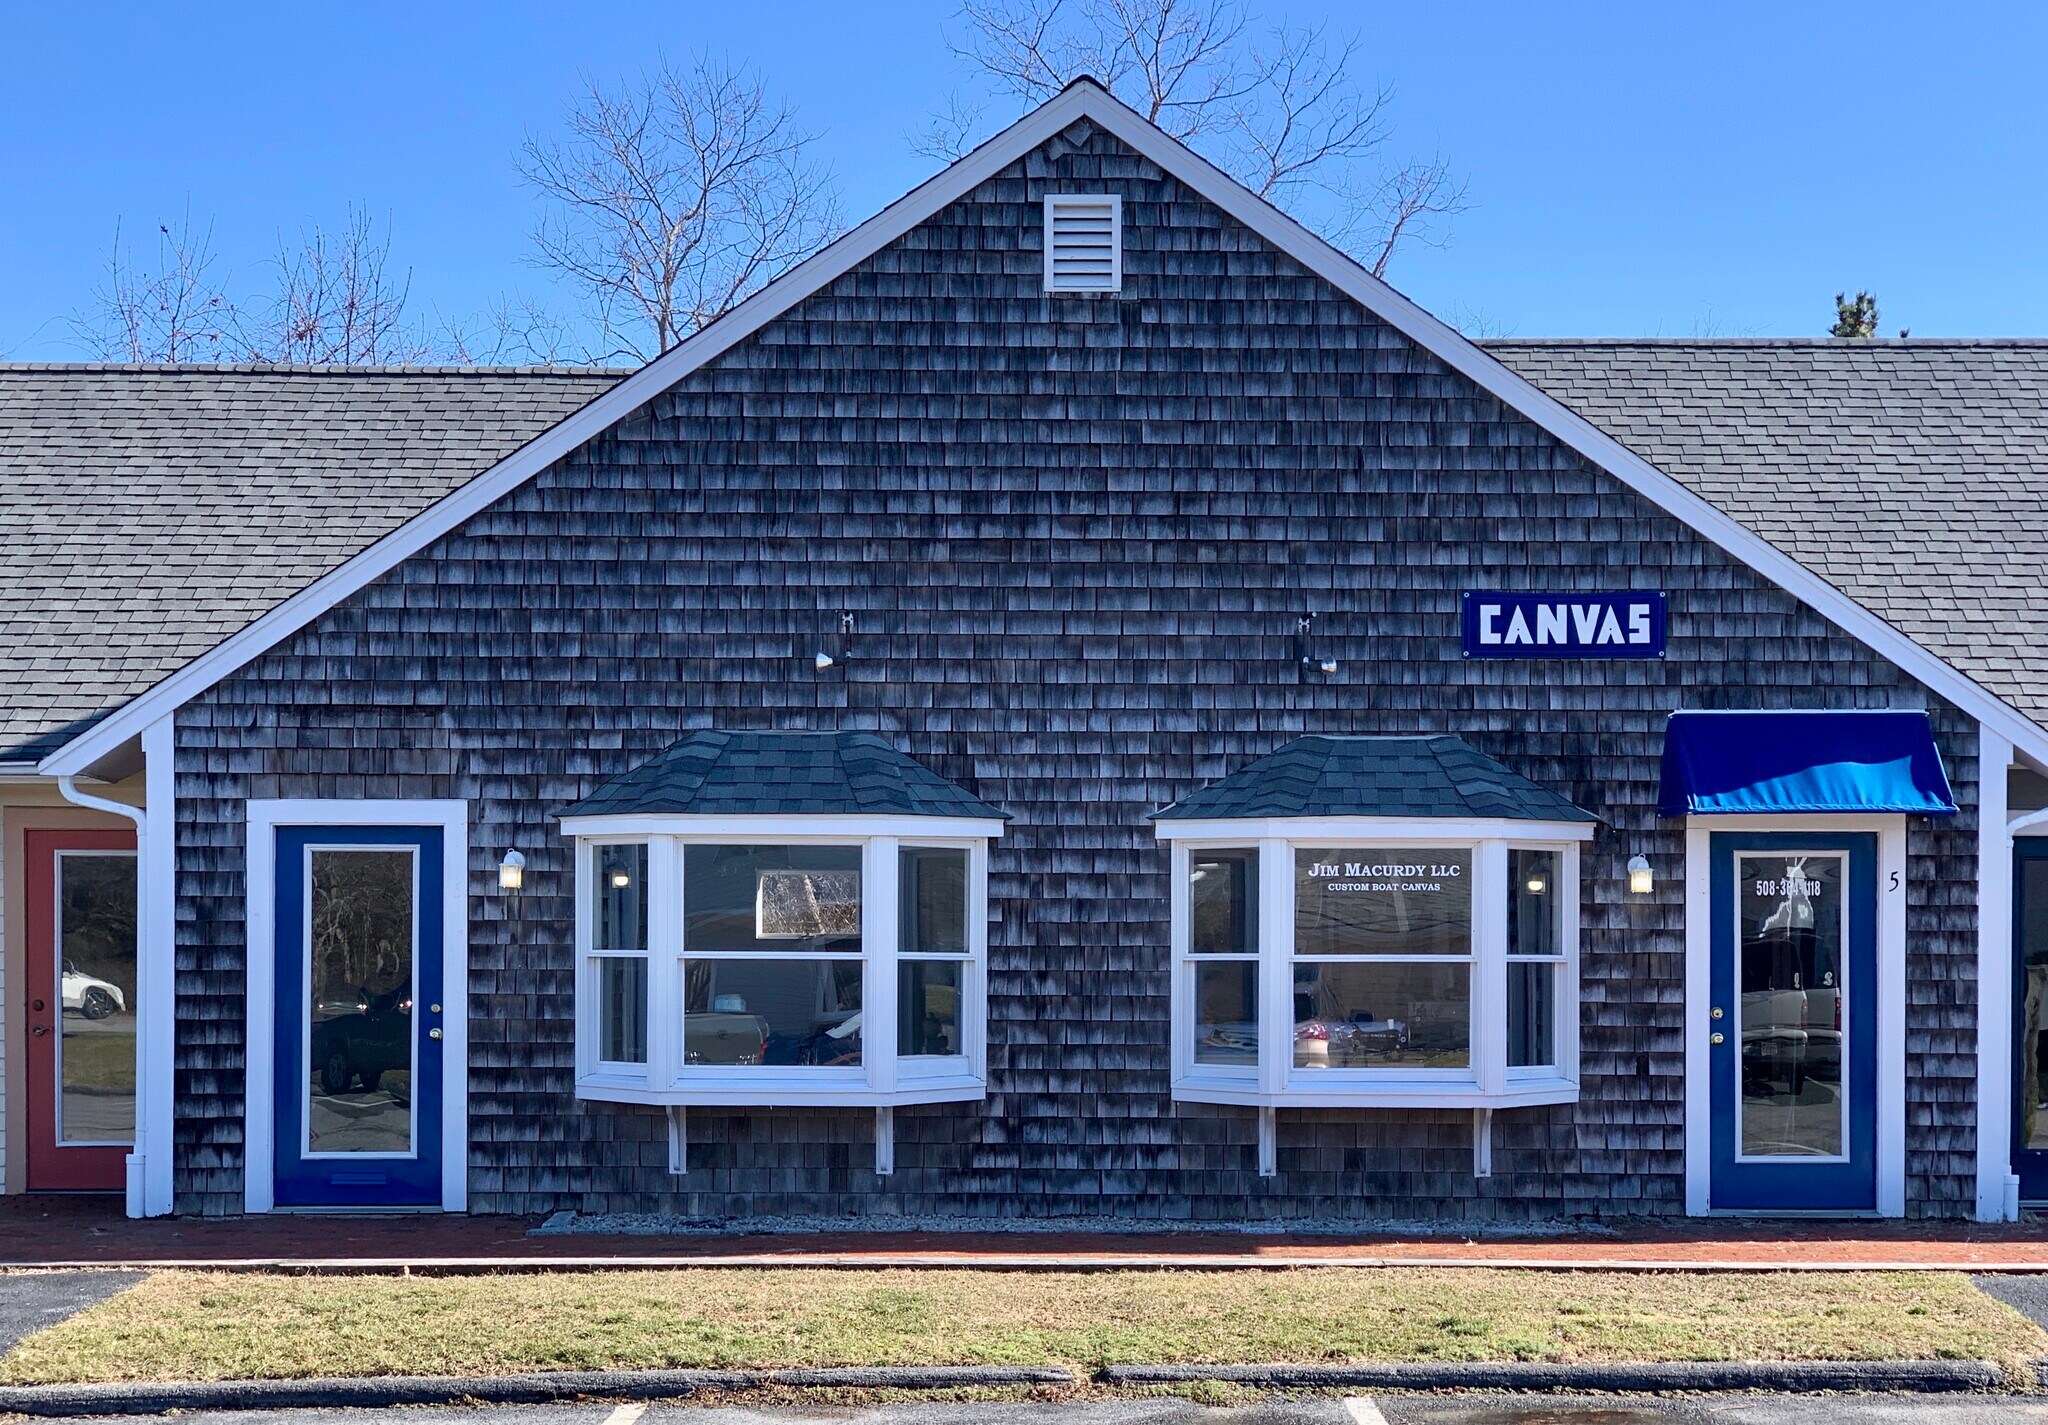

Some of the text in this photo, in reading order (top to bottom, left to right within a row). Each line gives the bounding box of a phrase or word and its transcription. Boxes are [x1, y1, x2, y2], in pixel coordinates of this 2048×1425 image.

[1479, 604, 1651, 645] CANVAS
[1308, 863, 1461, 877] JIM MACURDY LLC
[1328, 883, 1441, 891] CUSTOM BOAT CANVAS
[1888, 871, 1899, 892] 5
